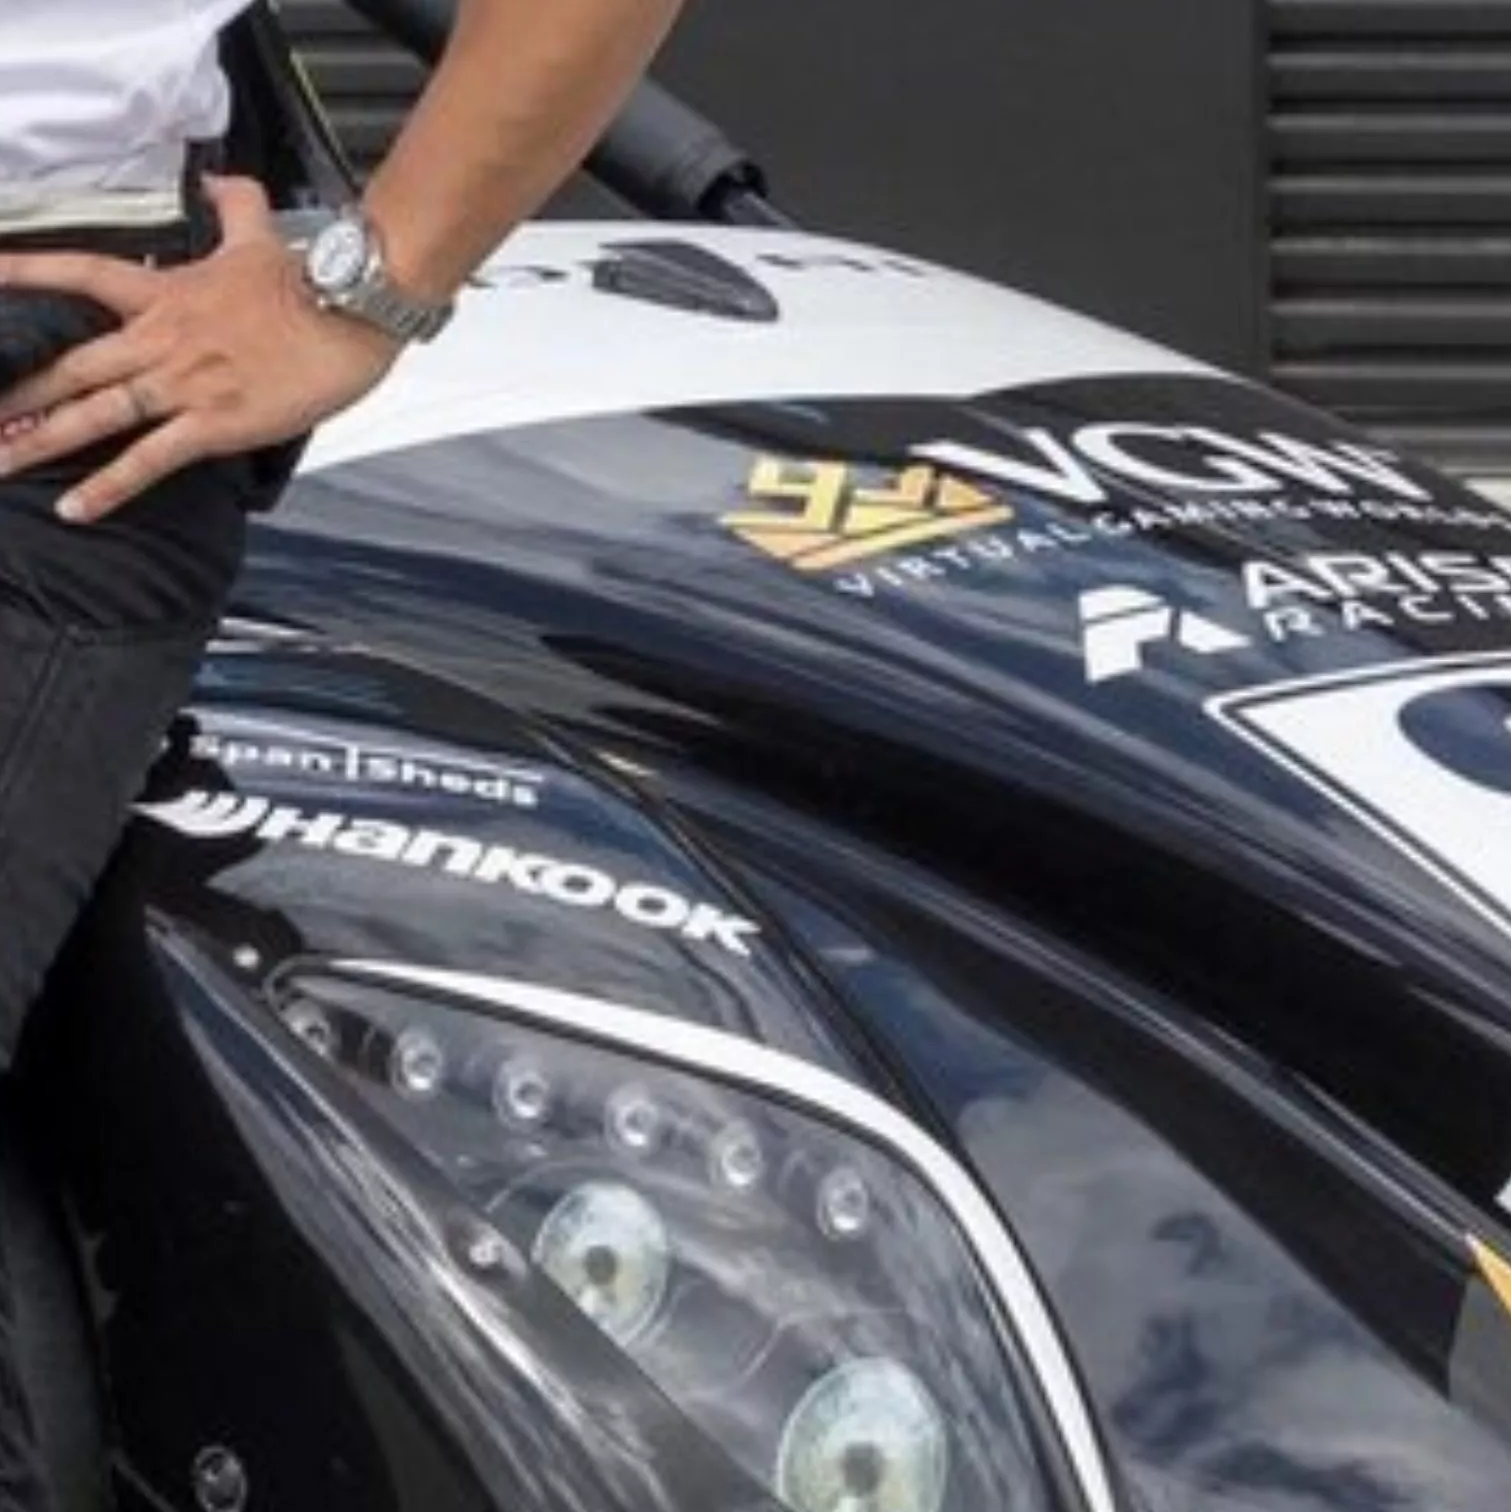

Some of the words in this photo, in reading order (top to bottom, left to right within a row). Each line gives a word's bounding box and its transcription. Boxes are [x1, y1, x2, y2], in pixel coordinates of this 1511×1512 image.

[907, 423, 1433, 502] VGW
[834, 522, 1091, 598] VIRTUAL
[367, 756, 540, 807] Sheds
